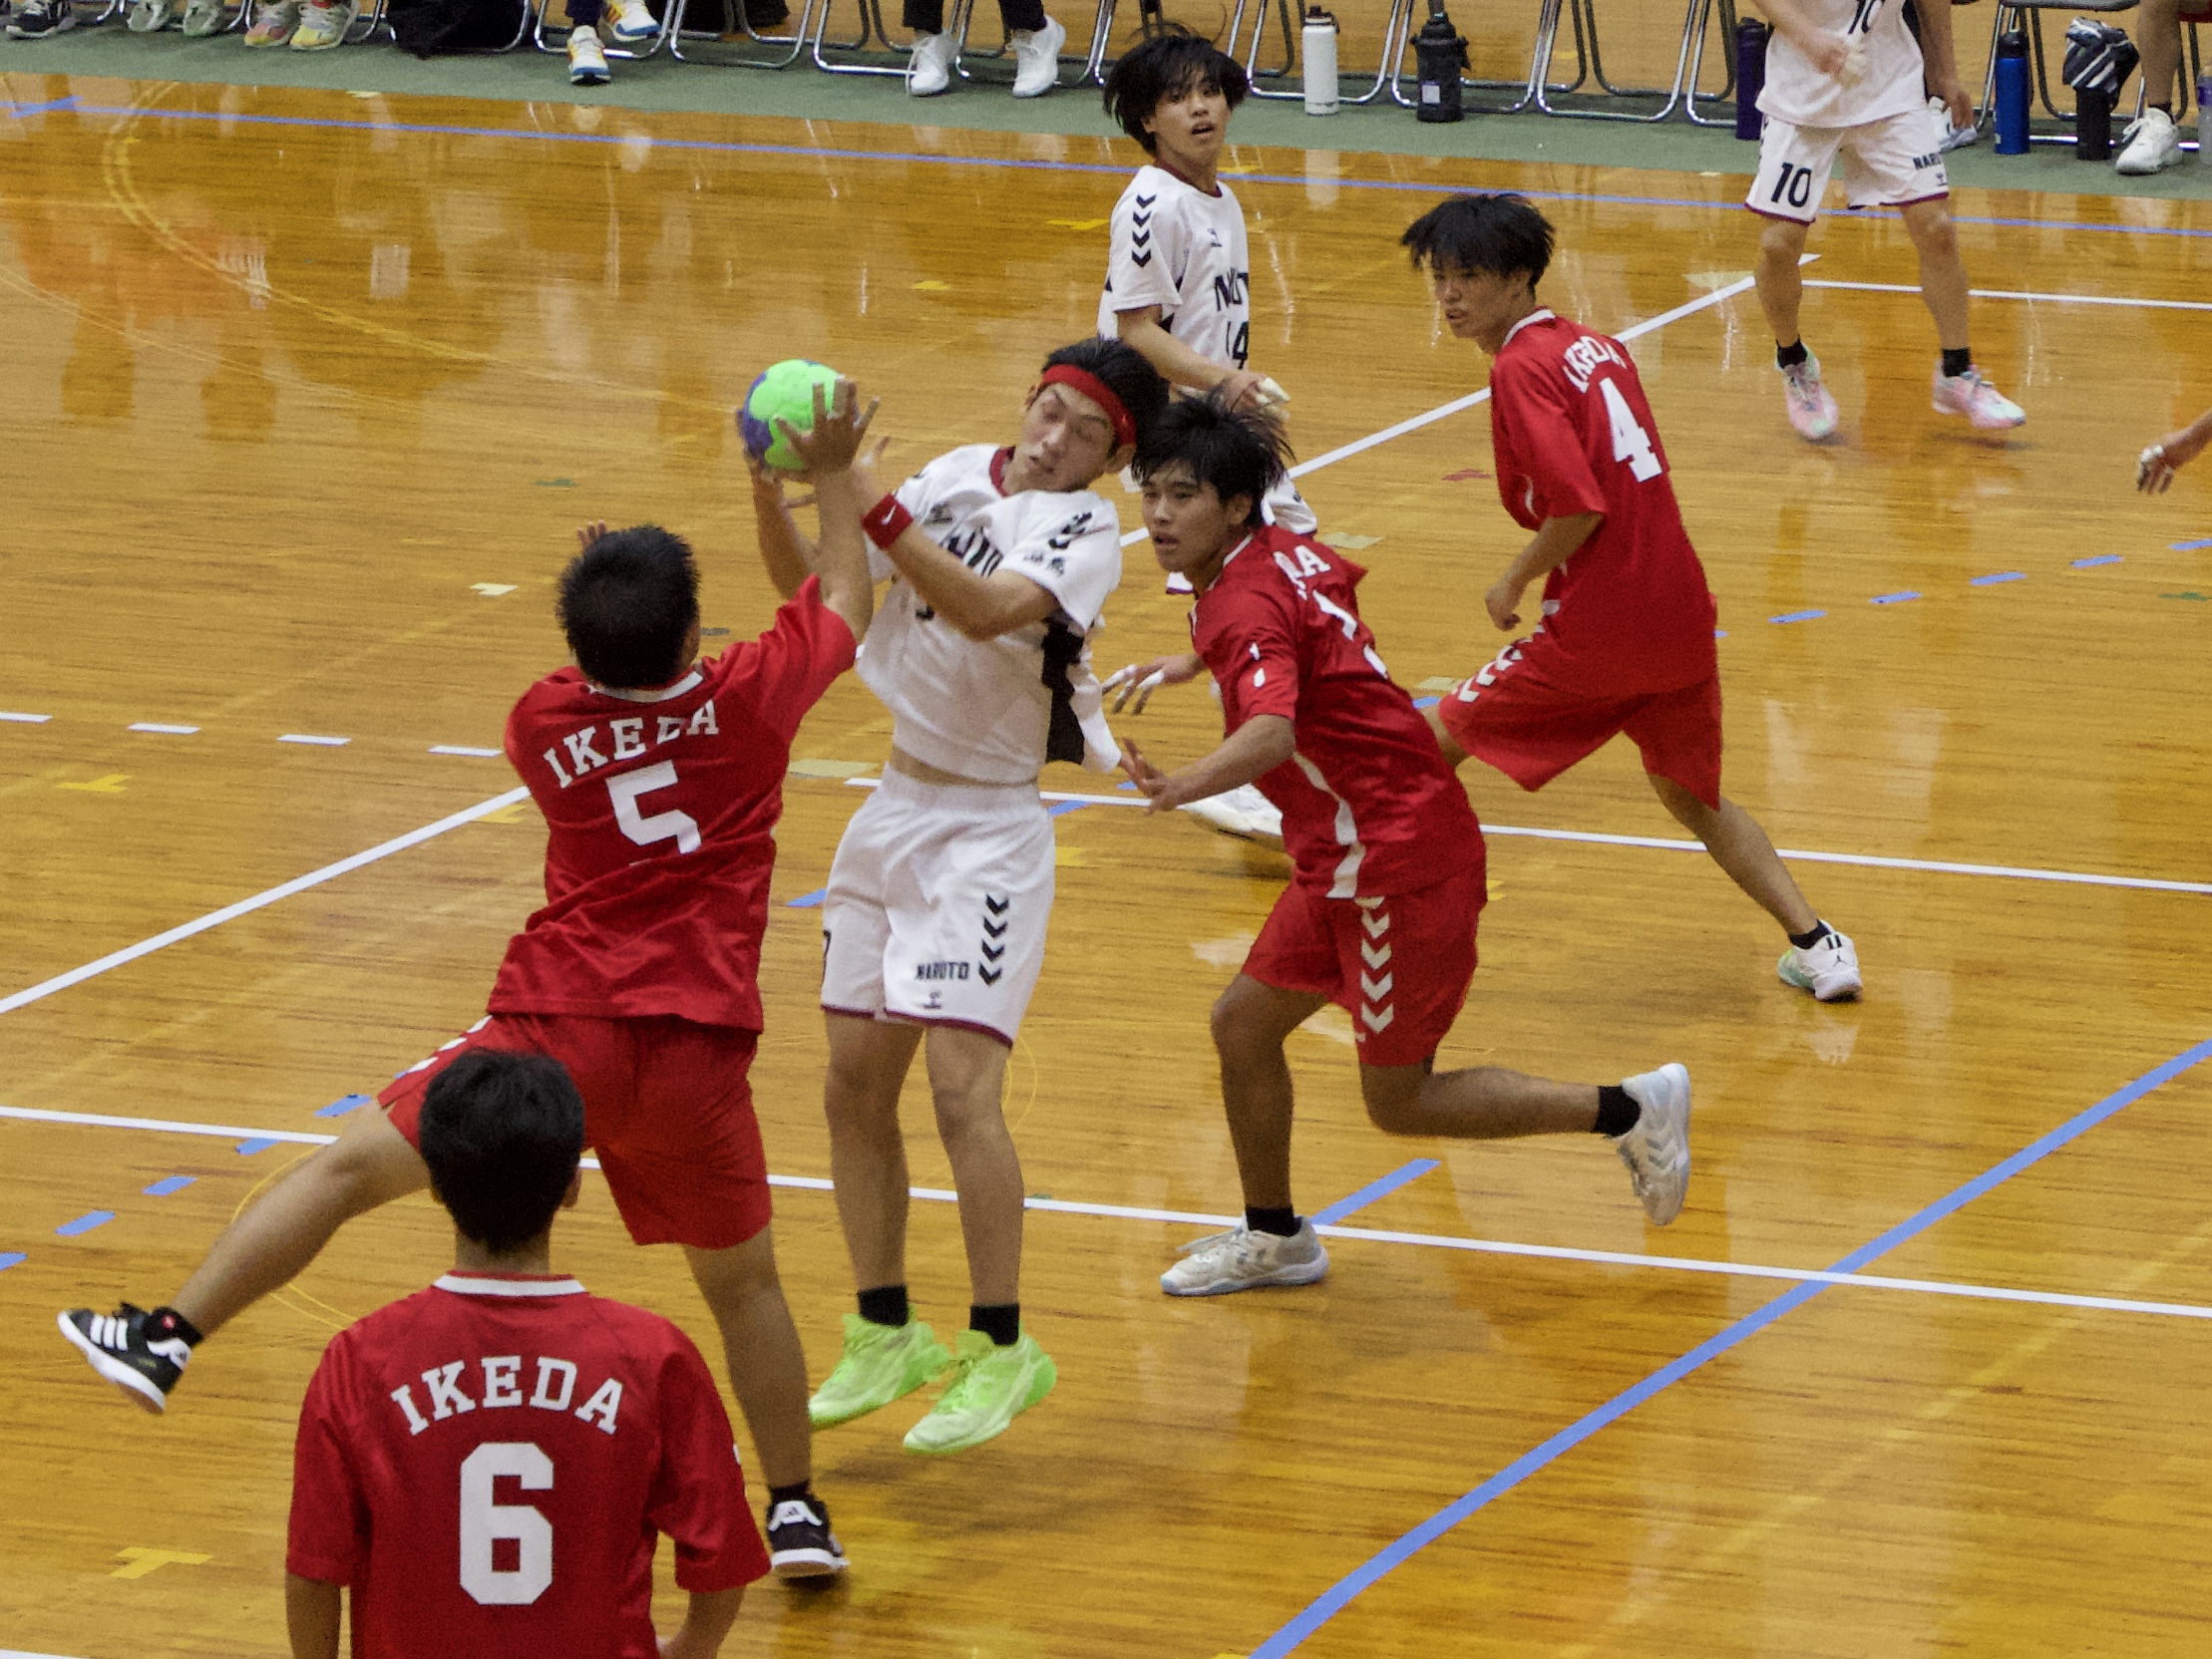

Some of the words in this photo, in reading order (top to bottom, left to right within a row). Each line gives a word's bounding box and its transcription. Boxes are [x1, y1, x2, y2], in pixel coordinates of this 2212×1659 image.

[1770, 162, 1812, 207] 10
[1599, 376, 1663, 483] 4
[604, 759, 702, 854] 5
[390, 1355, 624, 1437] IKEDA
[459, 1442, 554, 1606] 6
